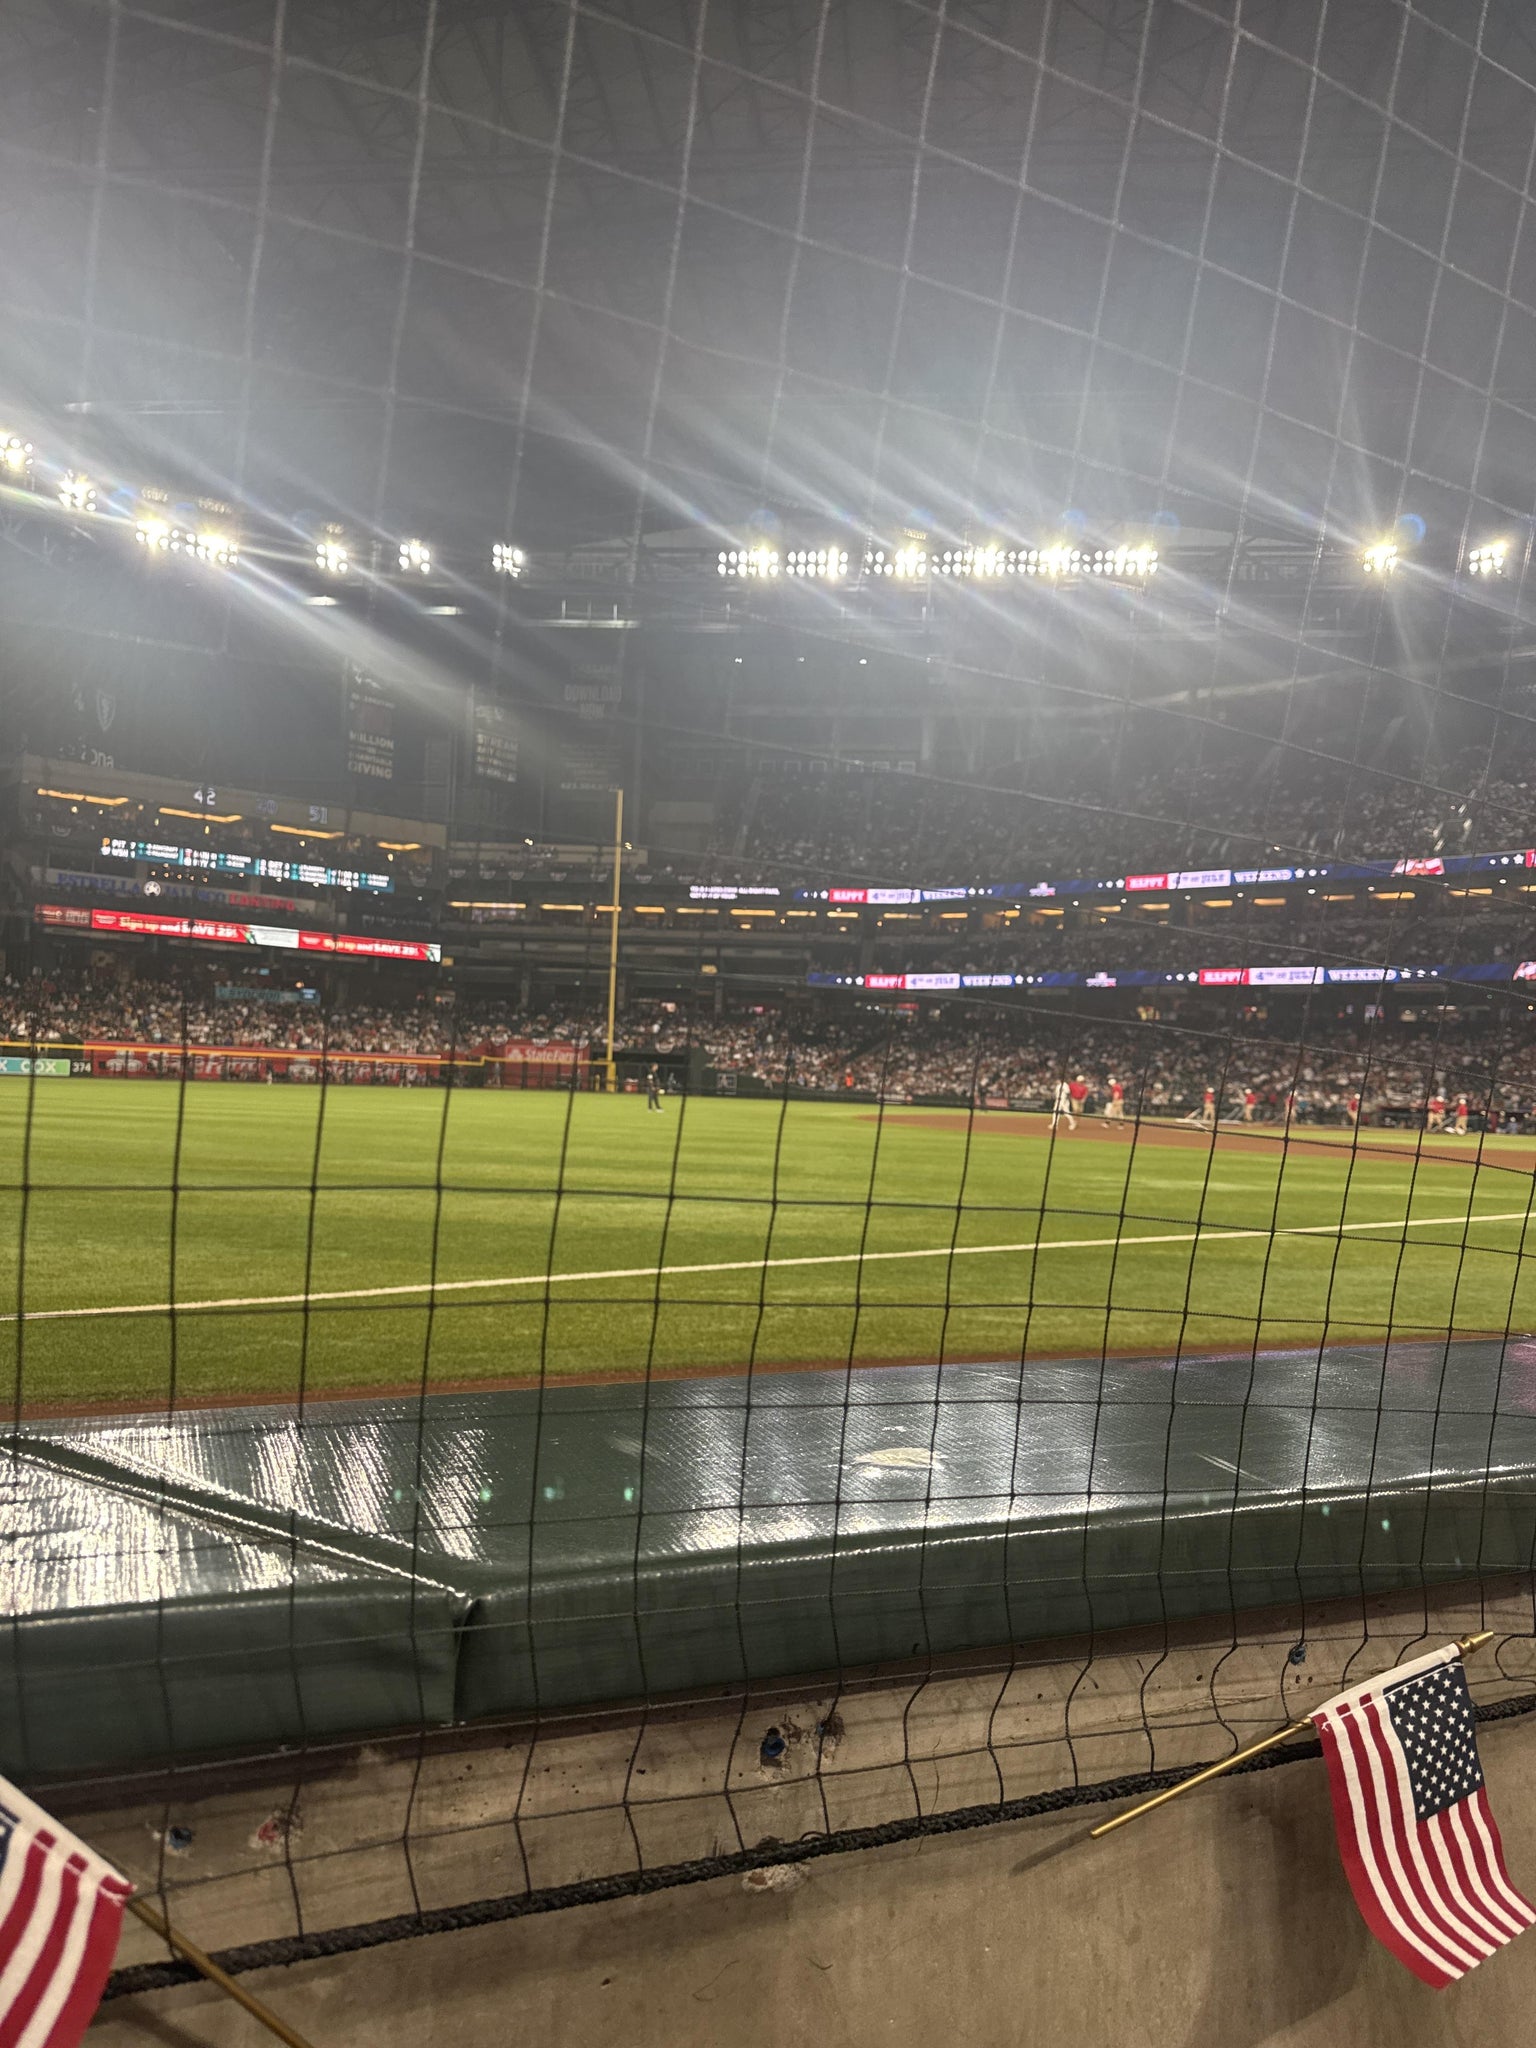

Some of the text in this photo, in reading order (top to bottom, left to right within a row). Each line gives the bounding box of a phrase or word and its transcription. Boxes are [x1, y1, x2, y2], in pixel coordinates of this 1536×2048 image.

[193, 788, 216, 806] 42
[309, 805, 328, 824] 51
[57, 872, 140, 896] ESTRELLA
[119, 916, 144, 931] Sign
[20, 1060, 57, 1072] COX
[72, 1060, 92, 1073] 374
